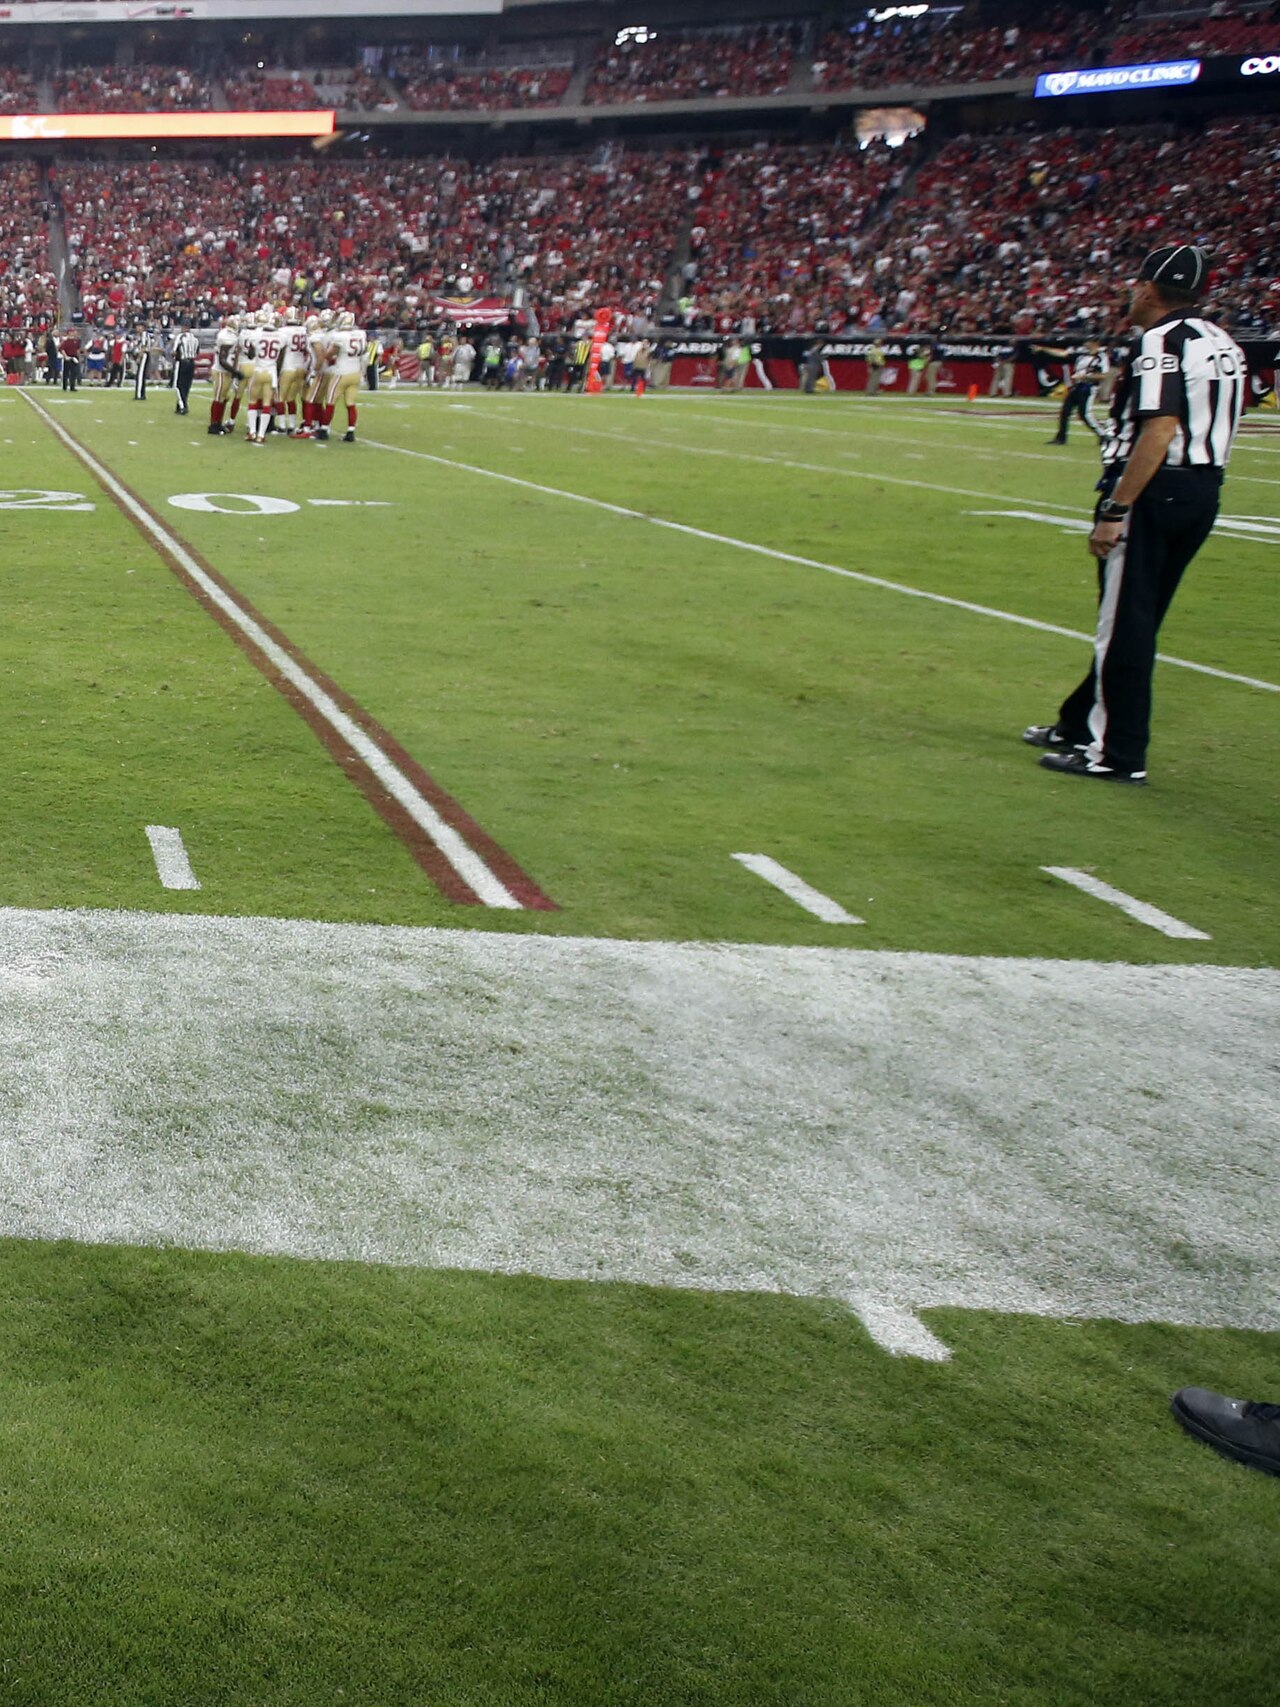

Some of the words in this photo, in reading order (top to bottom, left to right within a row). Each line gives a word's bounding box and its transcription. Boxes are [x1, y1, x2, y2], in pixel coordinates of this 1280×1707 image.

[1076, 72, 1130, 88] MAYO
[1128, 64, 1191, 82] CLINIC
[257, 339, 281, 360] 36
